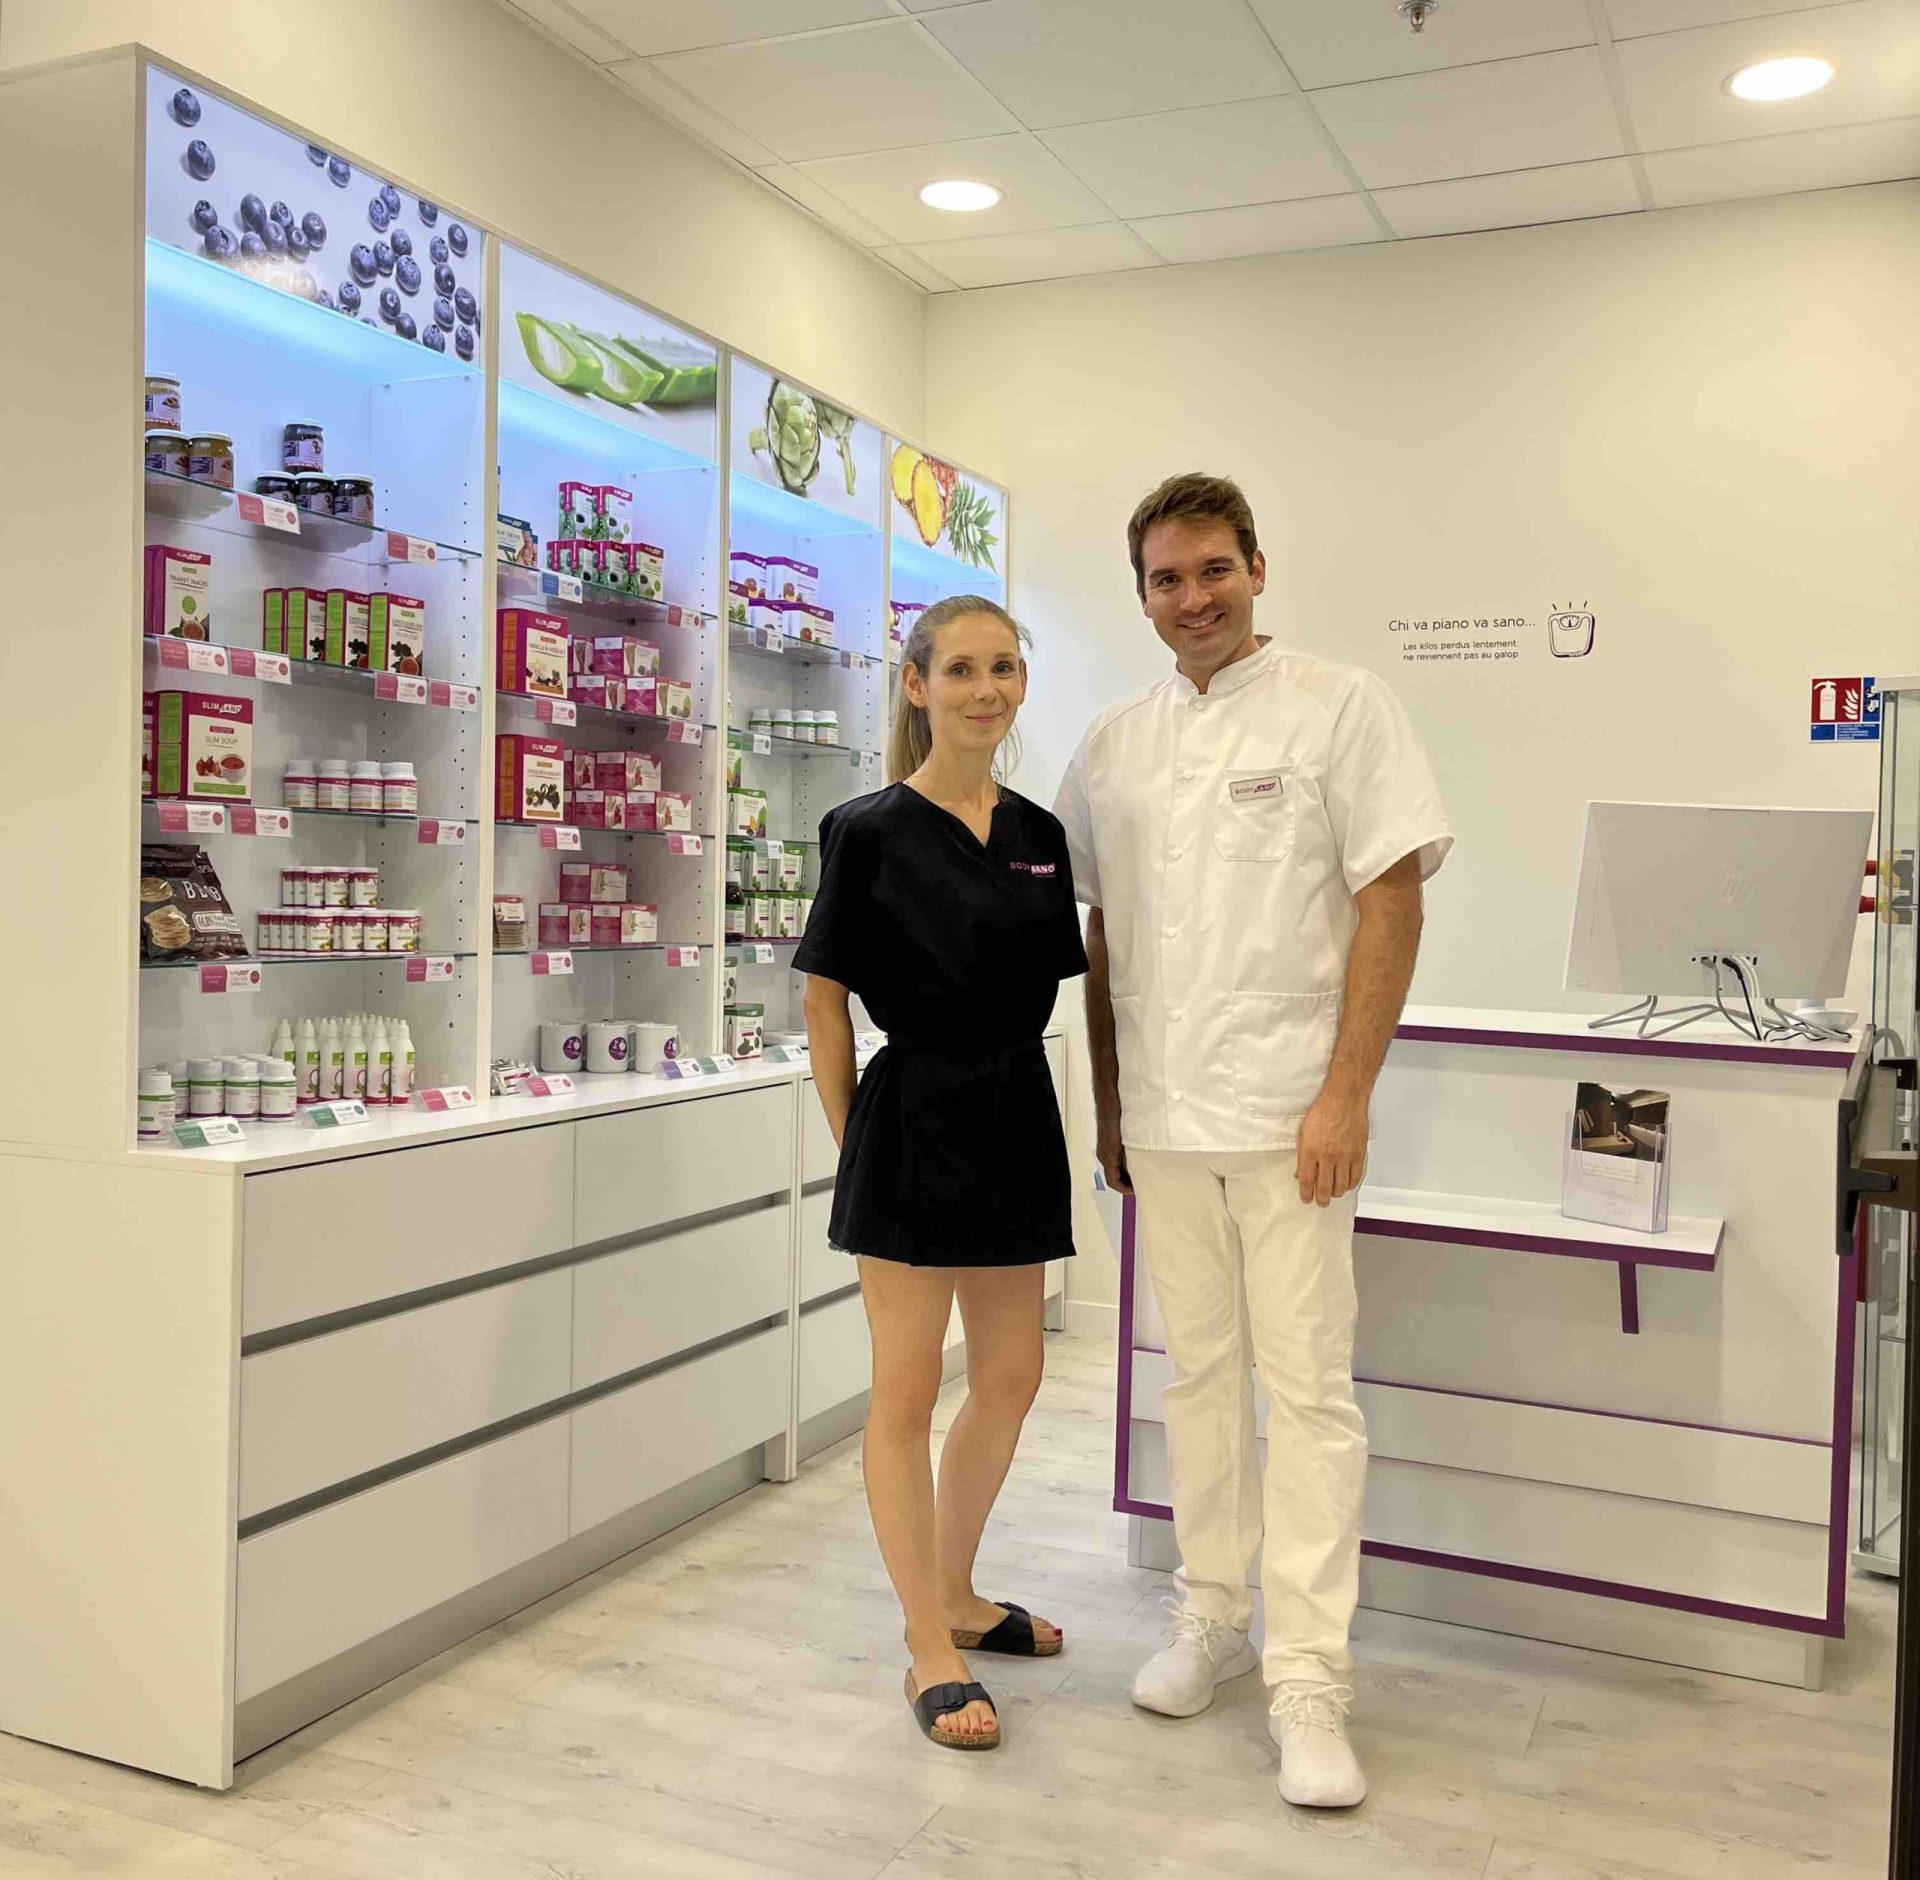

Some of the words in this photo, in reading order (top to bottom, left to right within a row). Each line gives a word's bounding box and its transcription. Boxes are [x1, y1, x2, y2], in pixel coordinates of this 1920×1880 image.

[1388, 619, 1409, 632] Chi
[1413, 621, 1428, 631] va
[1432, 618, 1469, 632] piano
[1473, 619, 1488, 629] va
[1493, 616, 1536, 628] sano...
[1403, 643, 1417, 651] Les
[1420, 642, 1438, 650] kilos
[1440, 640, 1470, 652] perdus
[1473, 639, 1516, 649] lentement
[1416, 652, 1462, 661] reviennent
[1464, 652, 1479, 660] pas
[1494, 650, 1519, 660] galop
[202, 701, 220, 710] SLIM
[220, 703, 242, 713] SANO
[205, 735, 220, 744] SLIM
[221, 736, 239, 745] SOUP
